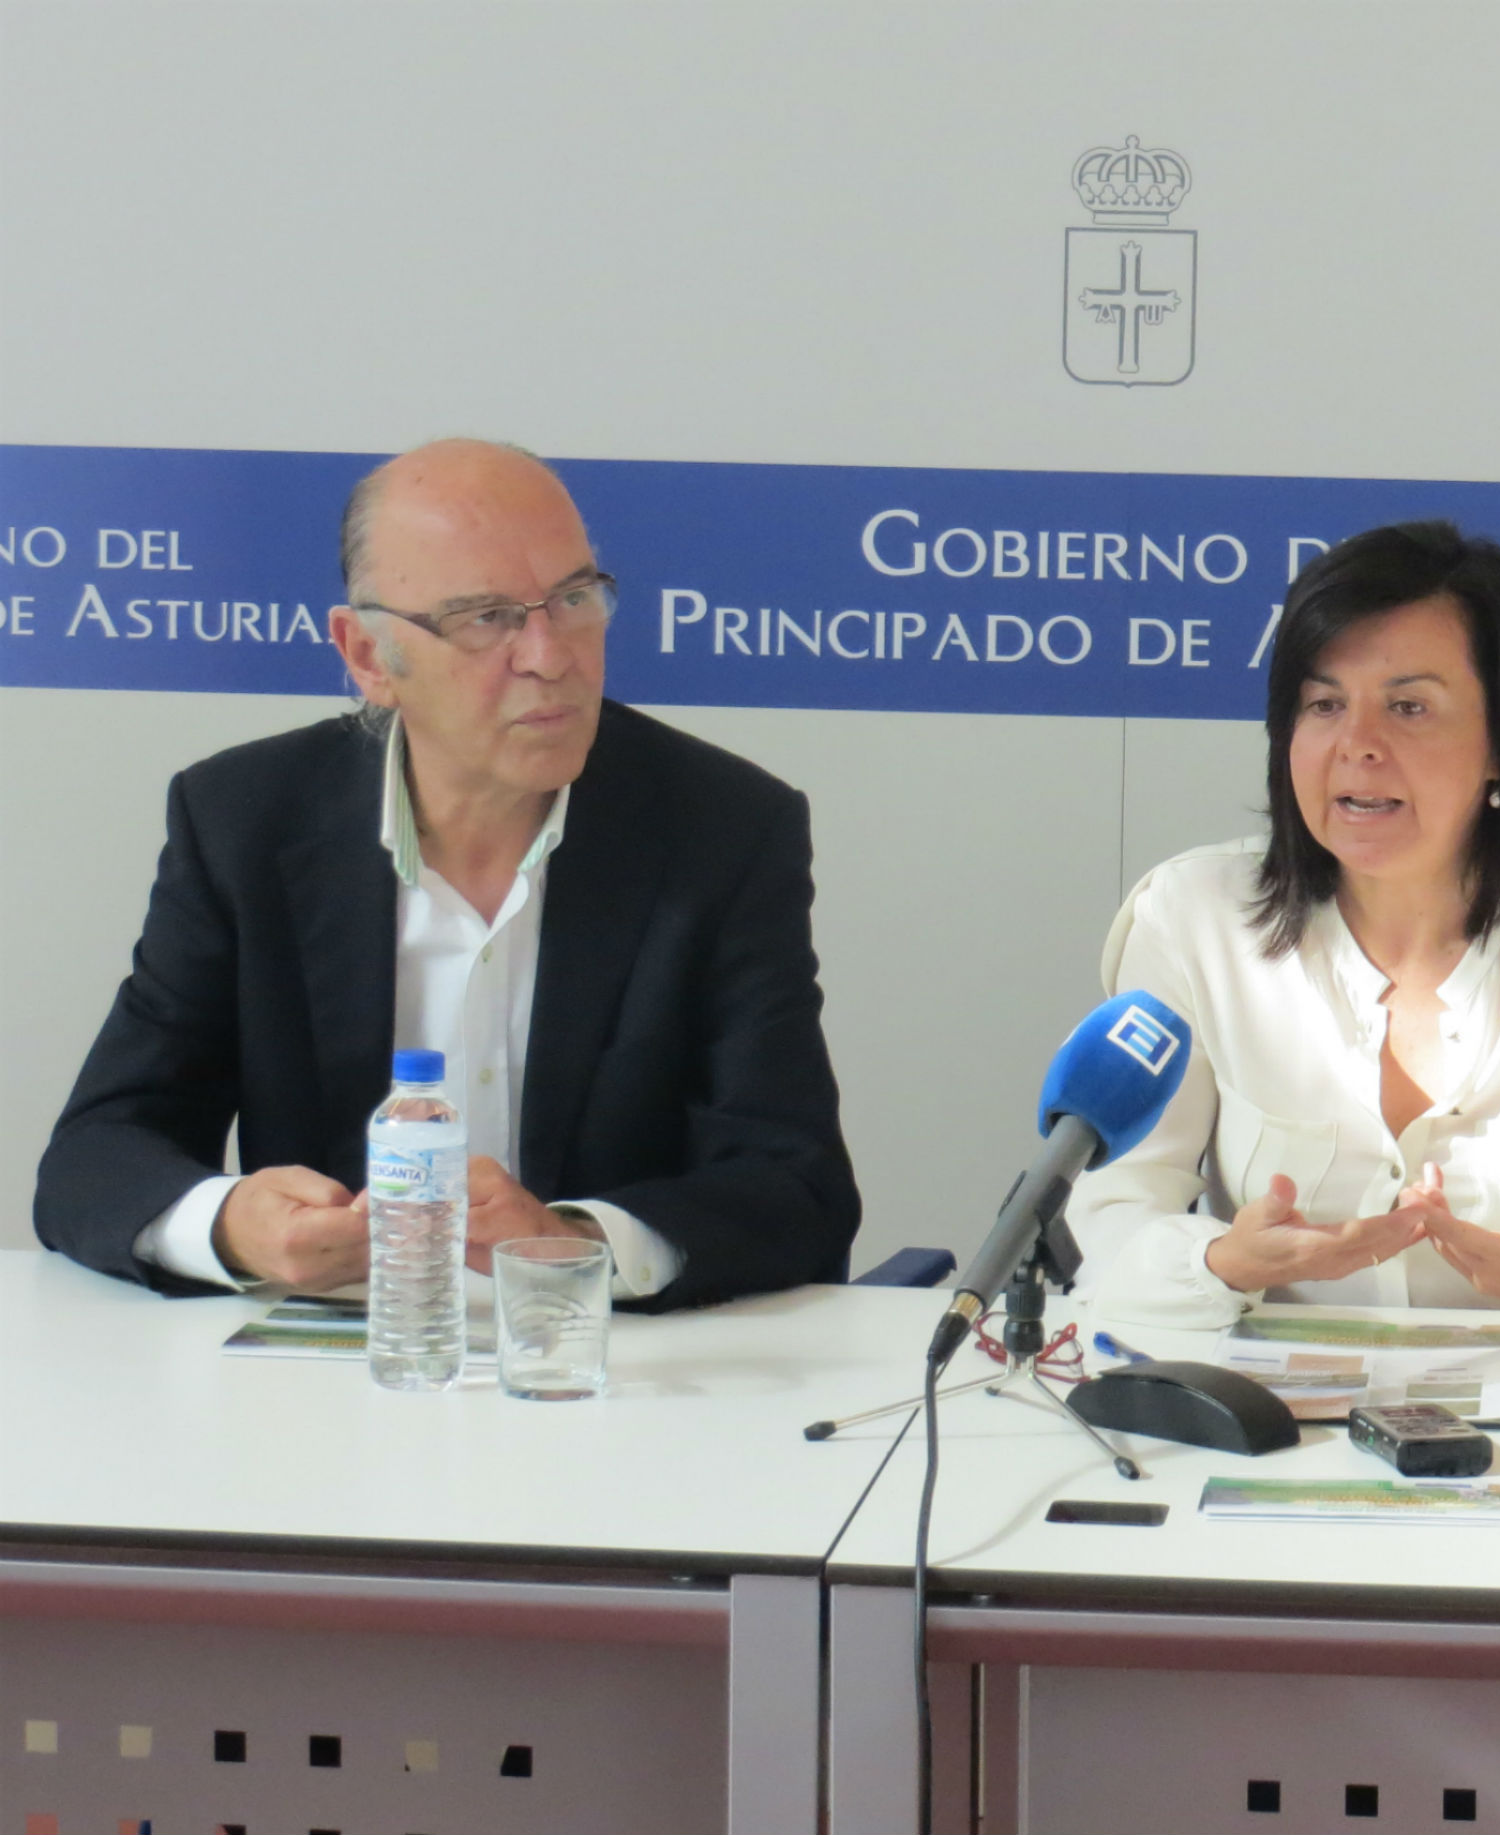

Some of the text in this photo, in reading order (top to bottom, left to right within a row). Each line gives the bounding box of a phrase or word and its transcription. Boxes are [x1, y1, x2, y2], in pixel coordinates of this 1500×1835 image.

[97, 528, 194, 571] DEL
[859, 508, 1249, 585] GOBIERNO
[65, 583, 336, 645] ASTURIA
[659, 587, 1093, 666] PRINCIPADO
[1127, 617, 1212, 669] DE
